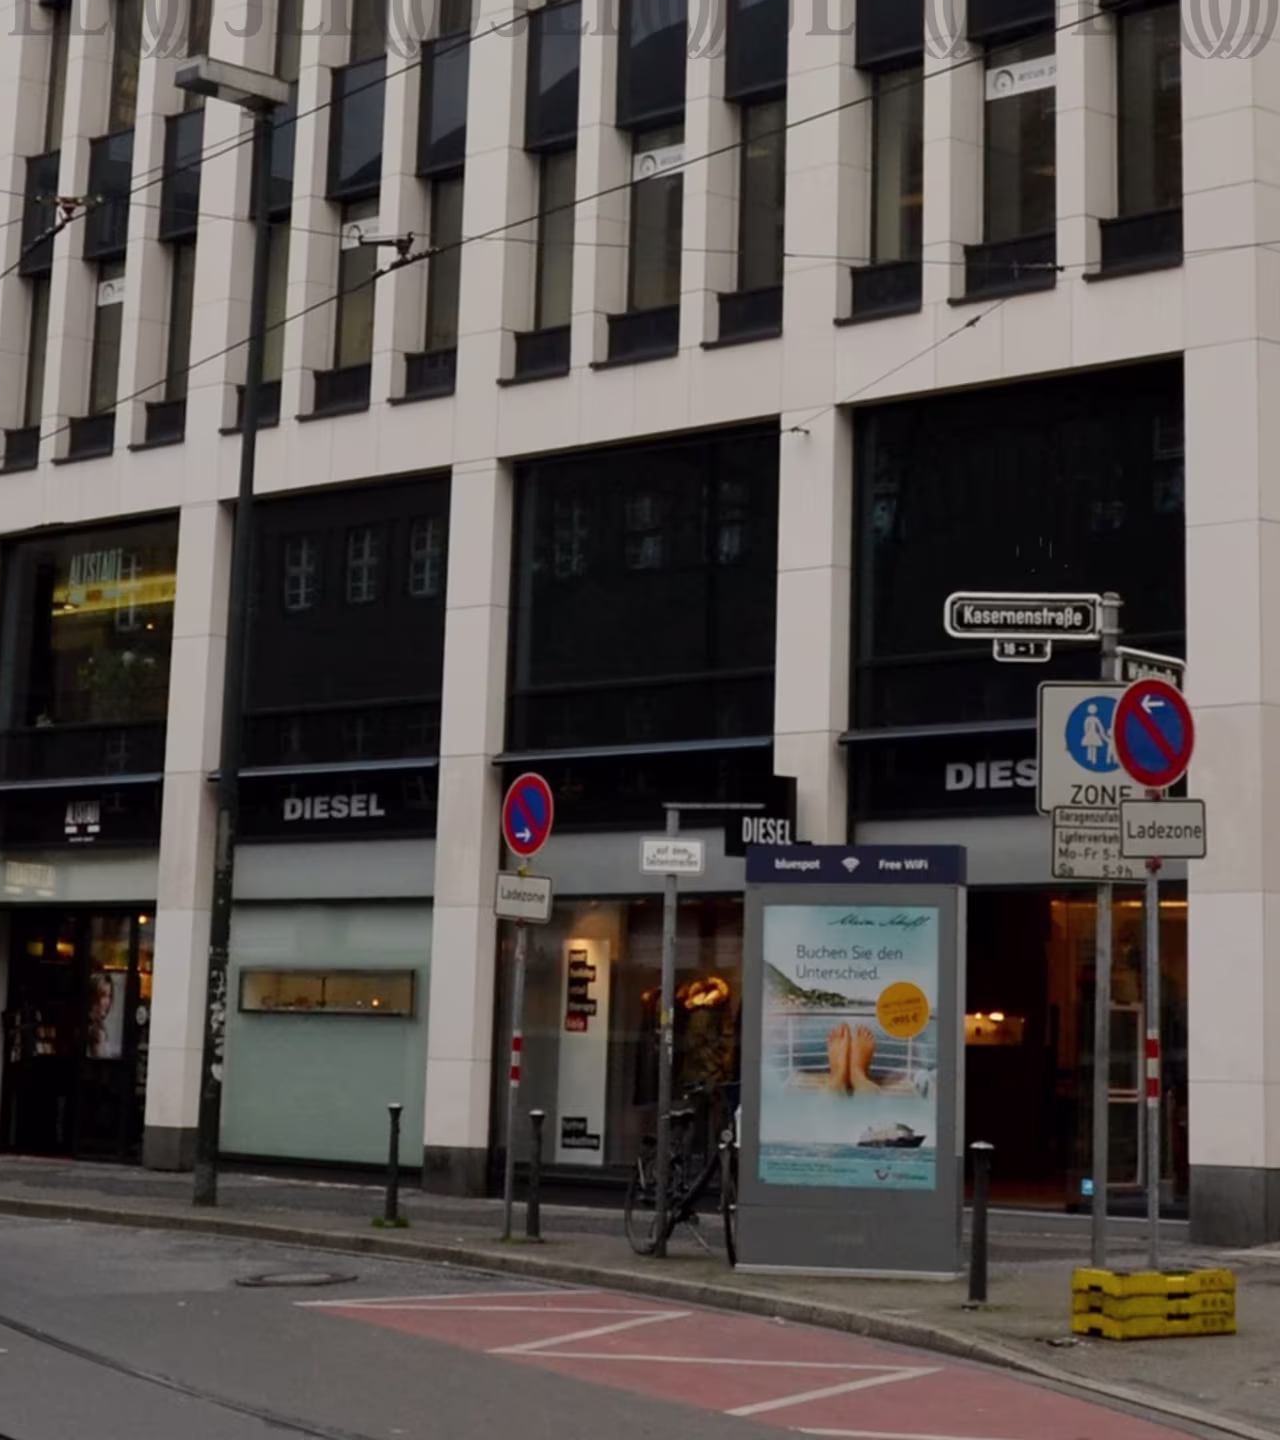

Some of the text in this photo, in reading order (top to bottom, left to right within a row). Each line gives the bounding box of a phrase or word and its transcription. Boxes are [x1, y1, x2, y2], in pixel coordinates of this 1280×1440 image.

[963, 605, 1082, 629] Kasernenstraße
[945, 760, 1037, 791] DIES
[283, 793, 385, 821] DIESEL
[1059, 811, 1120, 825] Garagenzufah
[742, 816, 792, 846] DIESEL
[1059, 831, 1120, 845] Lieferverkeh
[1127, 820, 1202, 840] Ladezone
[774, 858, 928, 872] bluespot Free WiFi
[501, 886, 545, 904] Ladezone
[796, 944, 903, 961] Buchen Sie den
[796, 964, 880, 980] Unterschied.
